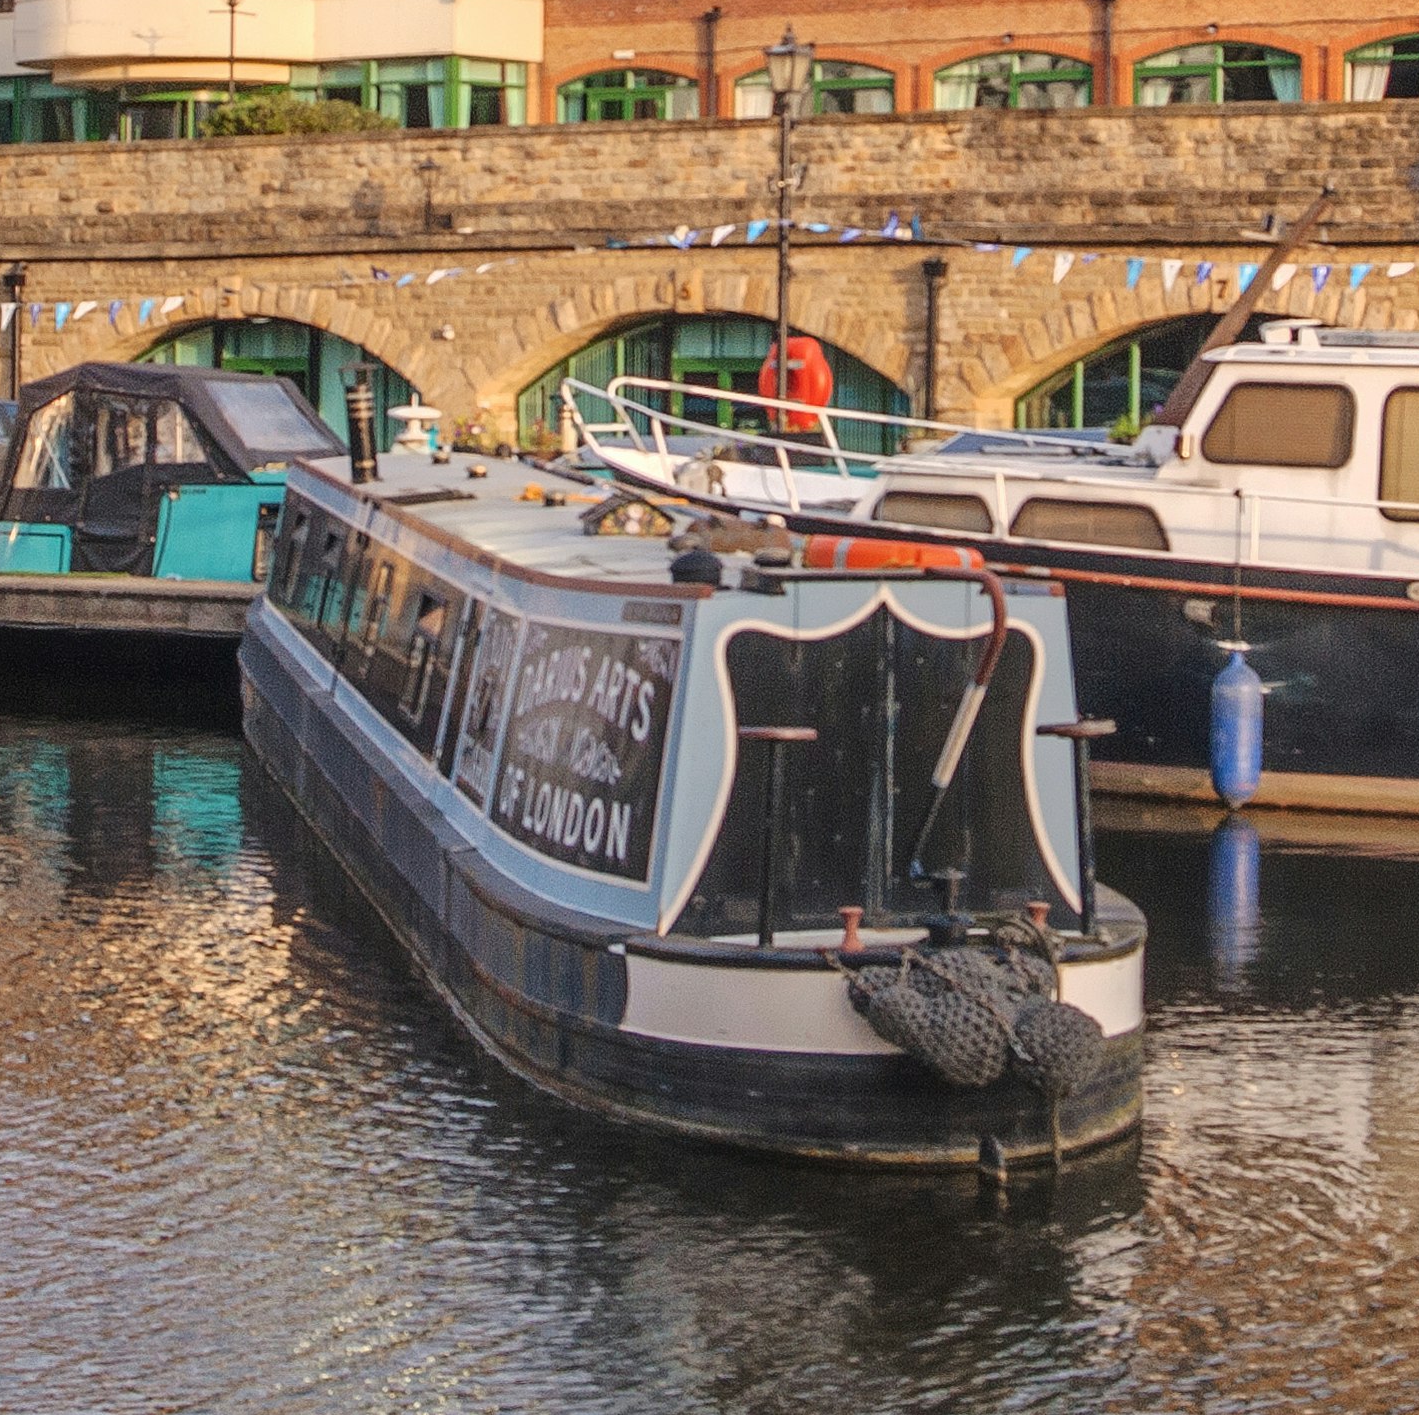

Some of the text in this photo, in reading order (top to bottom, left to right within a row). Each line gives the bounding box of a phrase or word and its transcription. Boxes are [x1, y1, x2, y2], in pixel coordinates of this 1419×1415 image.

[1215, 278, 1230, 299] 7
[587, 653, 656, 743] ARTS
[520, 781, 632, 861] LONDON
